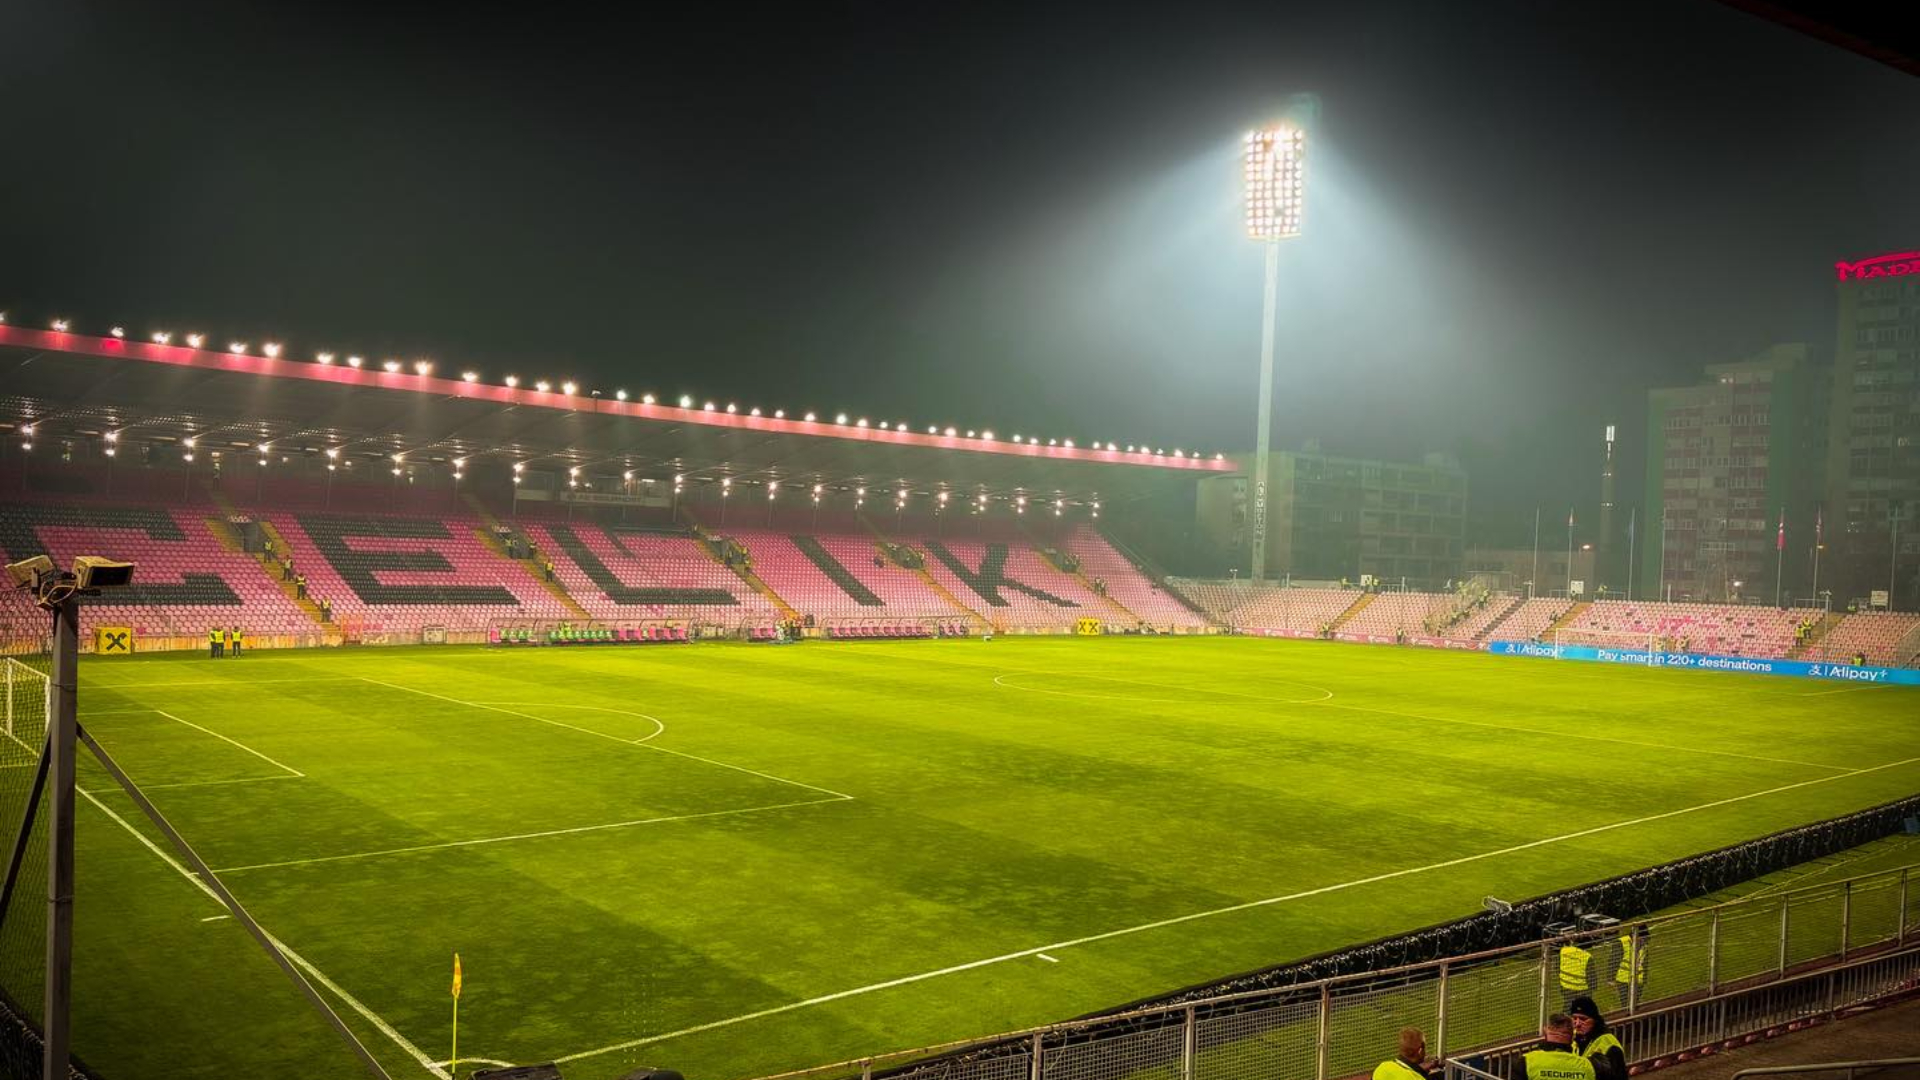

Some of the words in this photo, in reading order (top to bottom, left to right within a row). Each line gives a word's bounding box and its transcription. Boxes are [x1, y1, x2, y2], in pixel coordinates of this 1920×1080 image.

[1598, 650, 1617, 662] Pay
[1654, 655, 1664, 665] in
[1698, 656, 1771, 672] destinations
[1540, 1070, 1586, 1080] SECURITY
